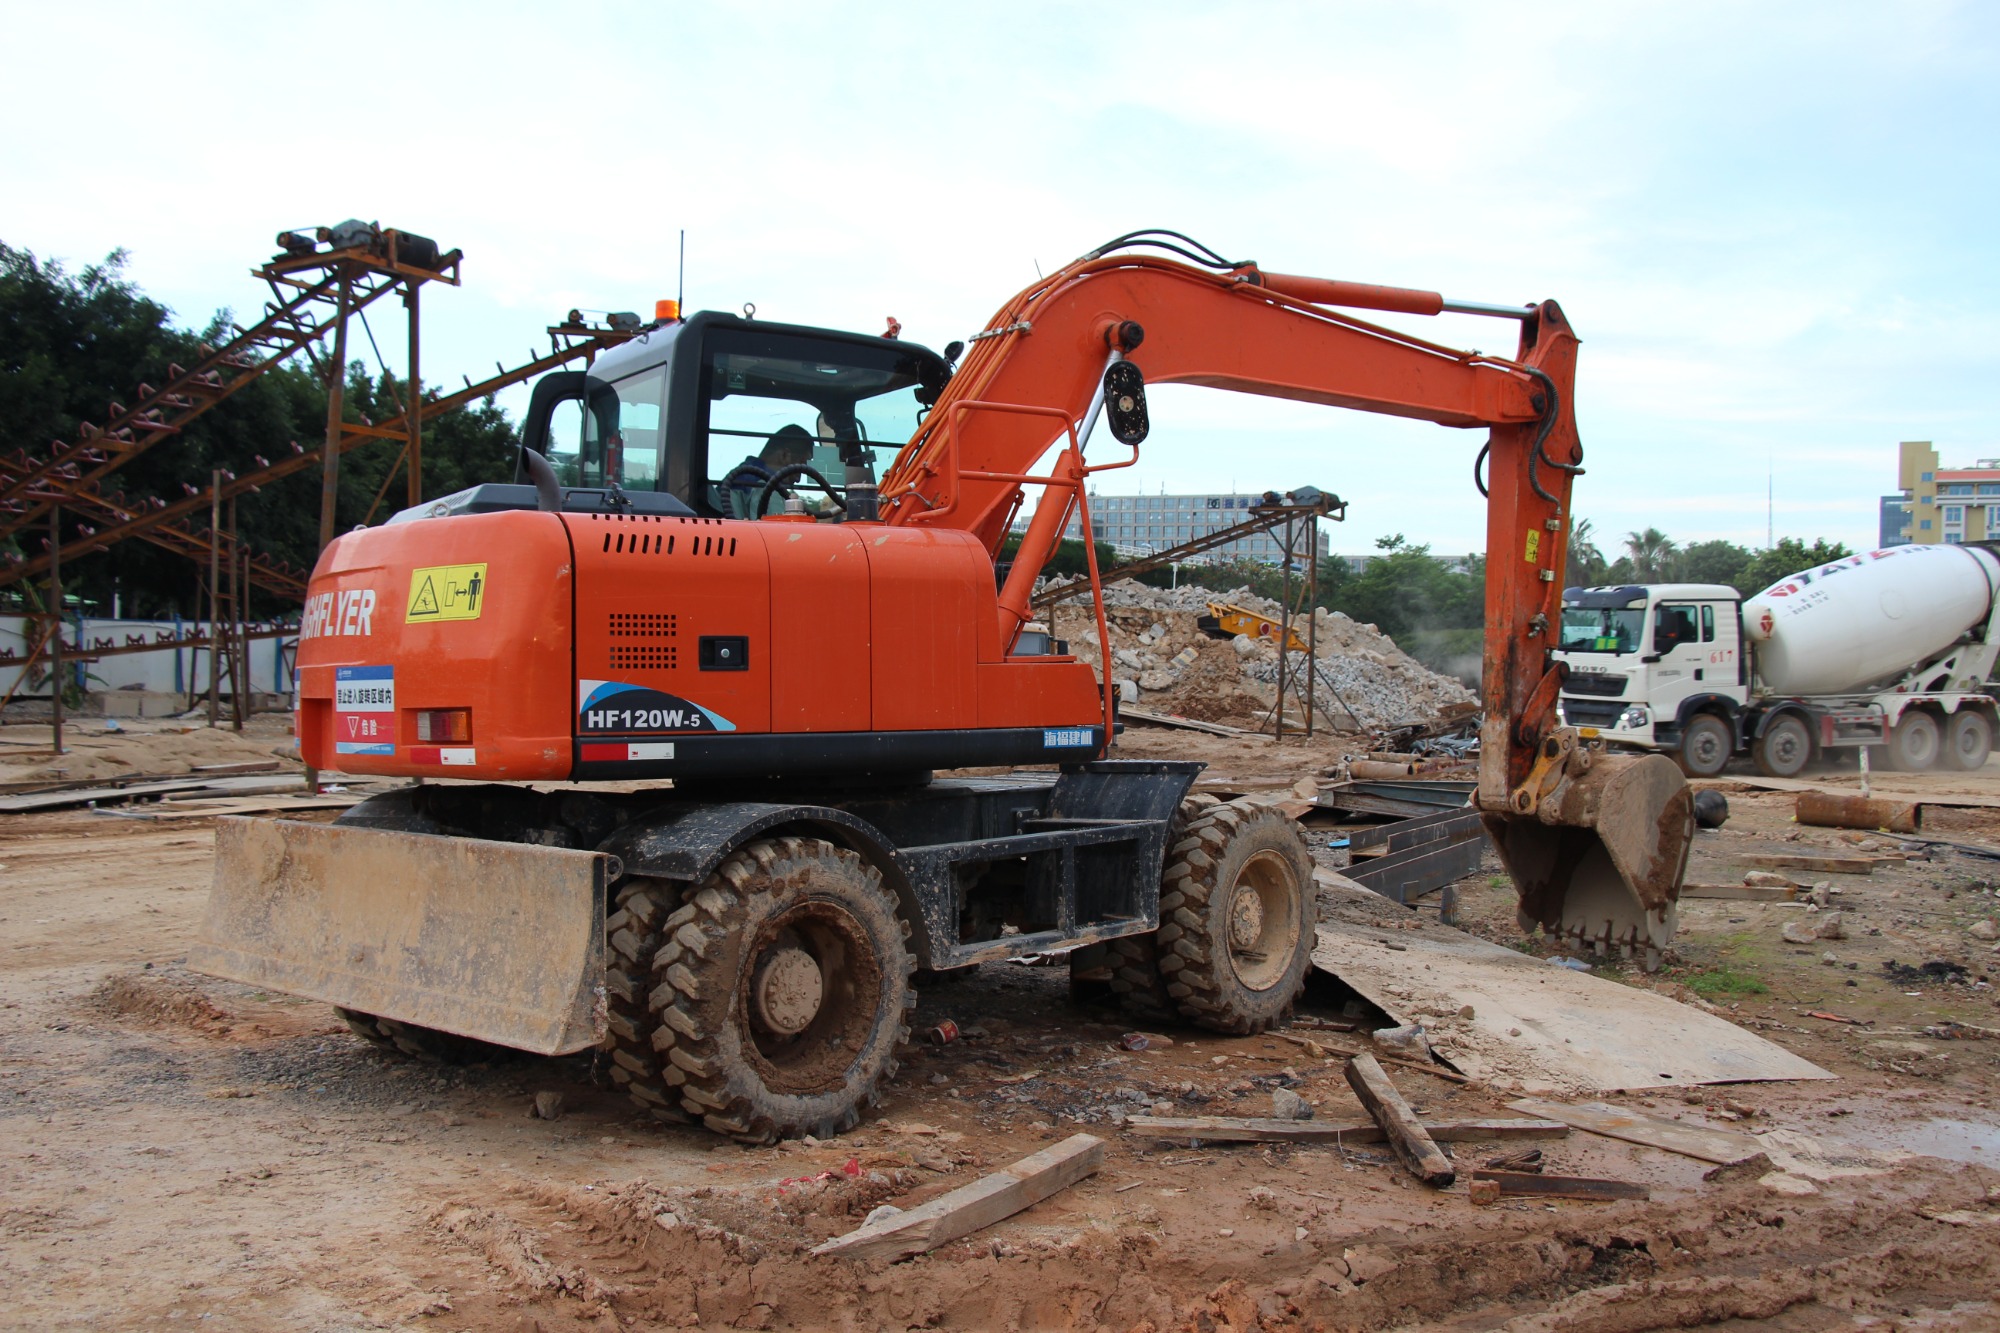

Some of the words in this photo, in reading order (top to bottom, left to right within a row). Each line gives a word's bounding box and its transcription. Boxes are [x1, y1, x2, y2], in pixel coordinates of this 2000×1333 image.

[1710, 651, 1733, 664] 617
[1574, 665, 1607, 673] HOWO
[588, 710, 700, 728] HF120W-5
[362, 719, 377, 736] 危险
